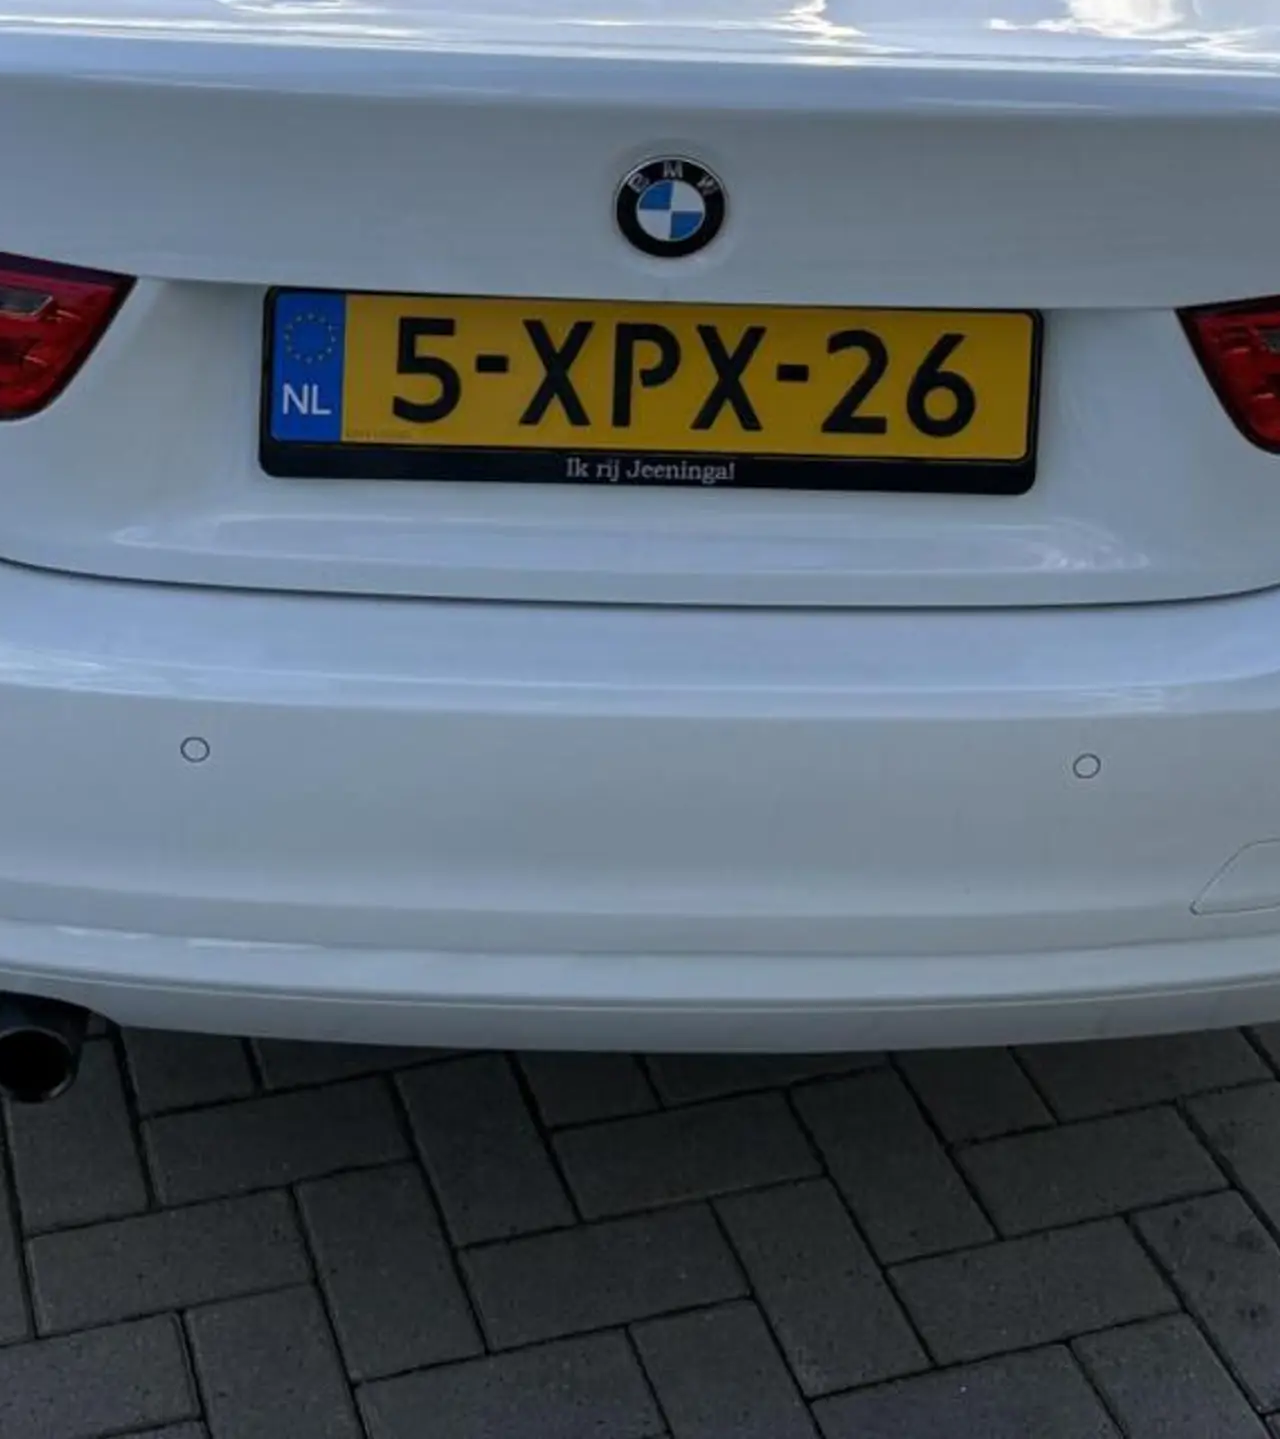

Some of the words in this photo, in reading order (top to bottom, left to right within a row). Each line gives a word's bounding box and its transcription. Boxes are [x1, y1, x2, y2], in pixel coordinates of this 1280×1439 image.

[391, 315, 977, 440] 5-XPX-26
[282, 383, 332, 416] NL
[566, 456, 590, 478] Ik
[595, 458, 621, 483] rij
[625, 460, 737, 486] Jeeninga!
